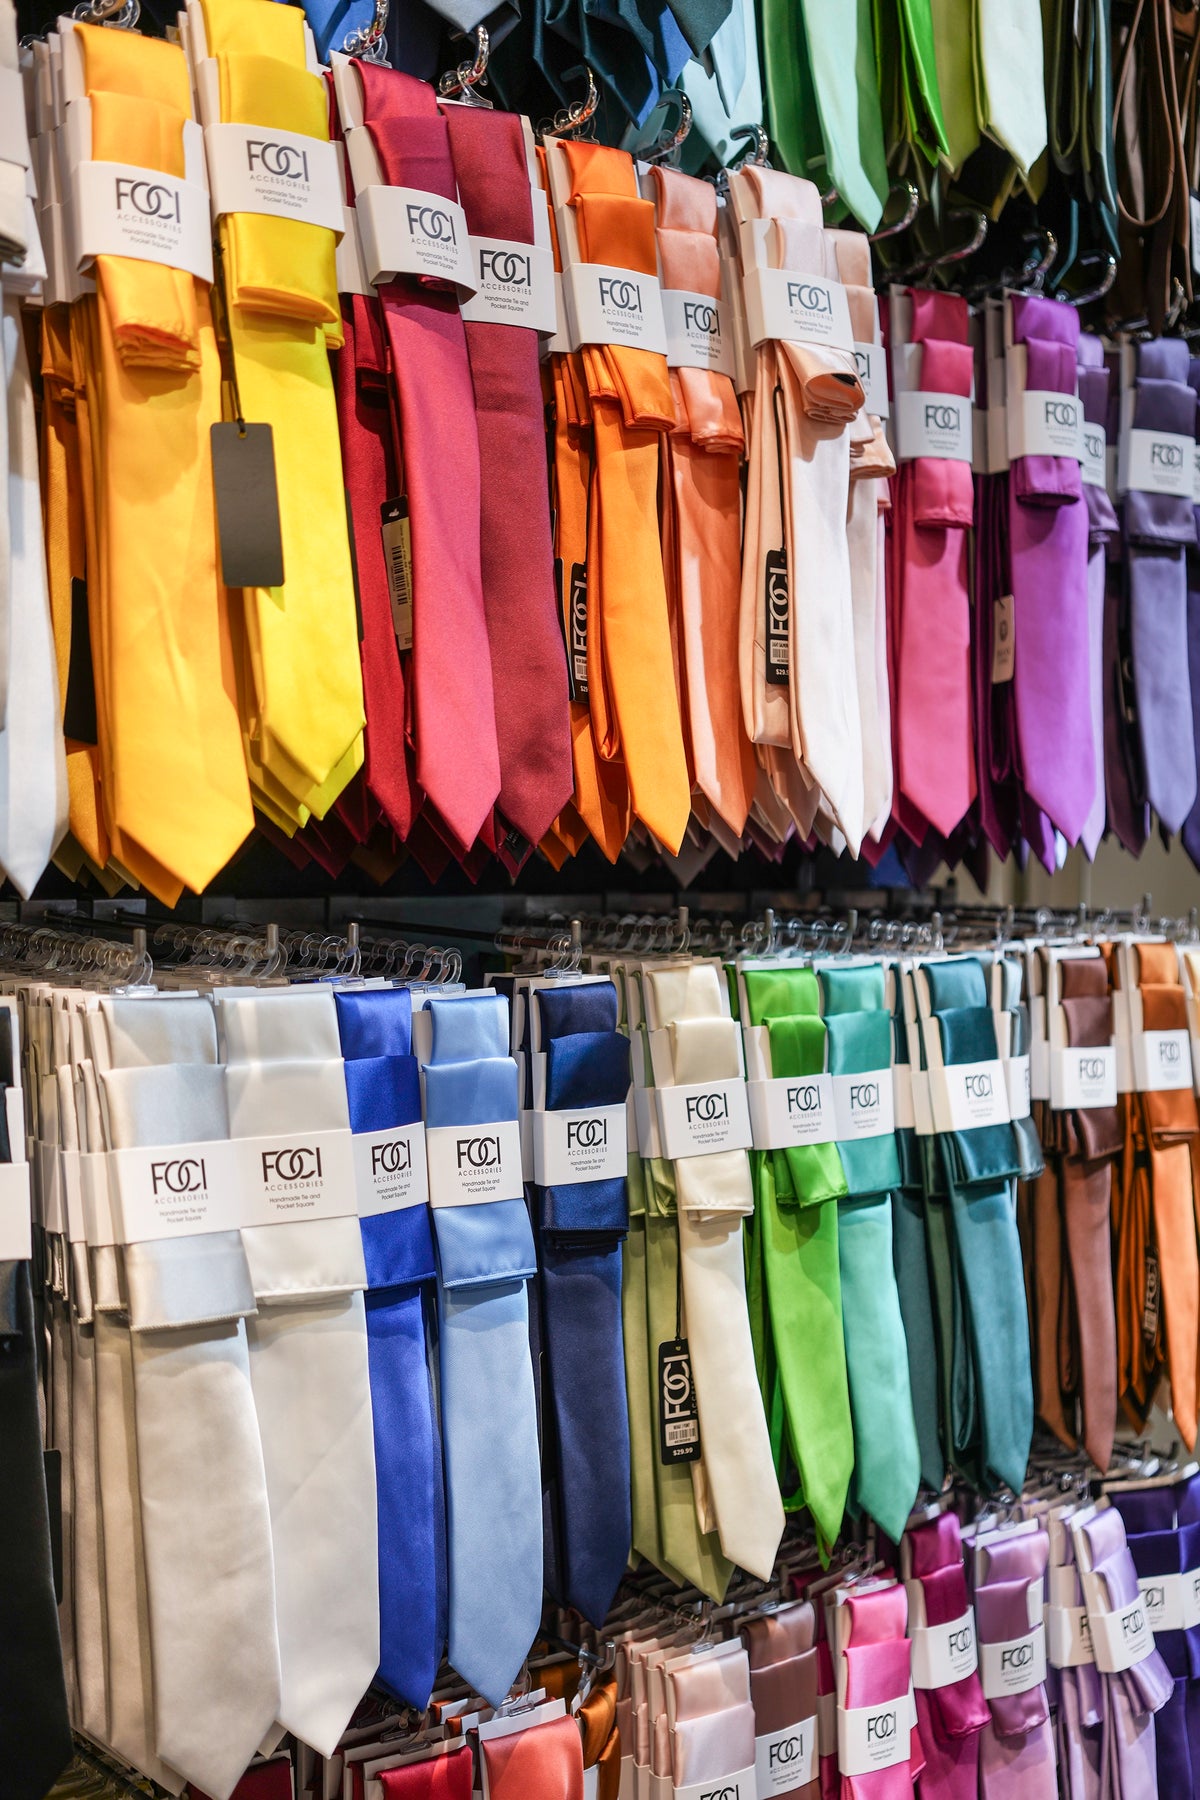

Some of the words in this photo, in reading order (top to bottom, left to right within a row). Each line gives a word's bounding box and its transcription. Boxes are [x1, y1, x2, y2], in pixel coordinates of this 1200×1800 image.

[246, 140, 309, 182] FOCI
[250, 174, 311, 192] ACCESSORIES
[116, 178, 180, 224] FOCI
[117, 214, 182, 234] ACCESSORIES
[406, 204, 456, 245] FOCI
[411, 238, 458, 254] ACCESSORIES
[480, 249, 531, 286] FOCI
[481, 283, 532, 295] ACCESSORIES
[599, 277, 642, 313] FOCI
[787, 282, 832, 314] FOCI
[602, 309, 644, 321] ACCESSORIES
[684, 302, 720, 336] FOCI
[926, 404, 960, 431] FOCI
[1045, 401, 1077, 428] FOCI
[1152, 443, 1183, 468] FOCI
[1079, 1058, 1105, 1079] FOCI
[787, 1085, 821, 1112] FOCI
[850, 1083, 879, 1109] FOCI
[966, 1073, 993, 1099] FOCI
[686, 1093, 728, 1123] FOCI
[568, 1118, 606, 1148] FOCI
[689, 1120, 730, 1130] ACCESSORIES
[262, 1147, 322, 1182] FOCI
[372, 1139, 411, 1175] FOCI
[457, 1137, 501, 1168] FOCI
[568, 1147, 607, 1156] ACCESSORIES
[151, 1158, 207, 1194] FOCI
[373, 1171, 412, 1184] ACCESSORIES
[458, 1166, 502, 1177] ACCESSORIES
[155, 1193, 208, 1204] ACCESSORIES
[265, 1181, 324, 1192] ACCESSORIES
[664, 1354, 691, 1420] FOCI
[673, 1447, 693, 1456] $29.99
[1002, 1642, 1034, 1670] FOCI
[868, 1711, 896, 1742] FOCI
[770, 1734, 803, 1768] FOCI
